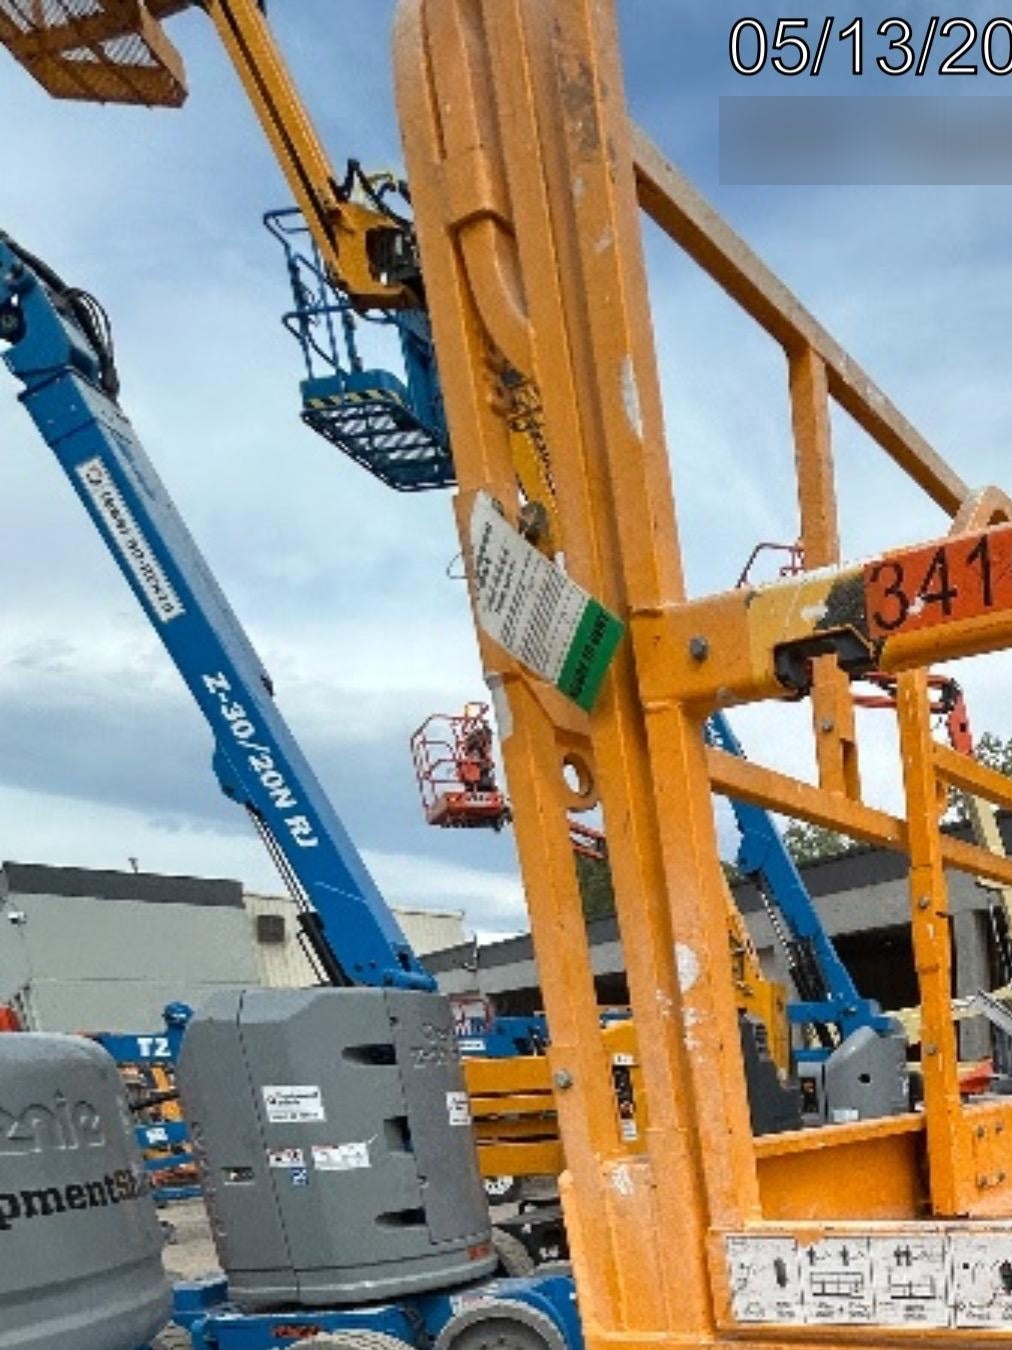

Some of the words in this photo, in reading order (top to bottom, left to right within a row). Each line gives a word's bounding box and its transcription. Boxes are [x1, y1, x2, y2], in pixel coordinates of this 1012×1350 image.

[202, 671, 299, 809] Z-30/20N
[283, 815, 320, 848] RJ
[136, 1036, 172, 1058] TZ
